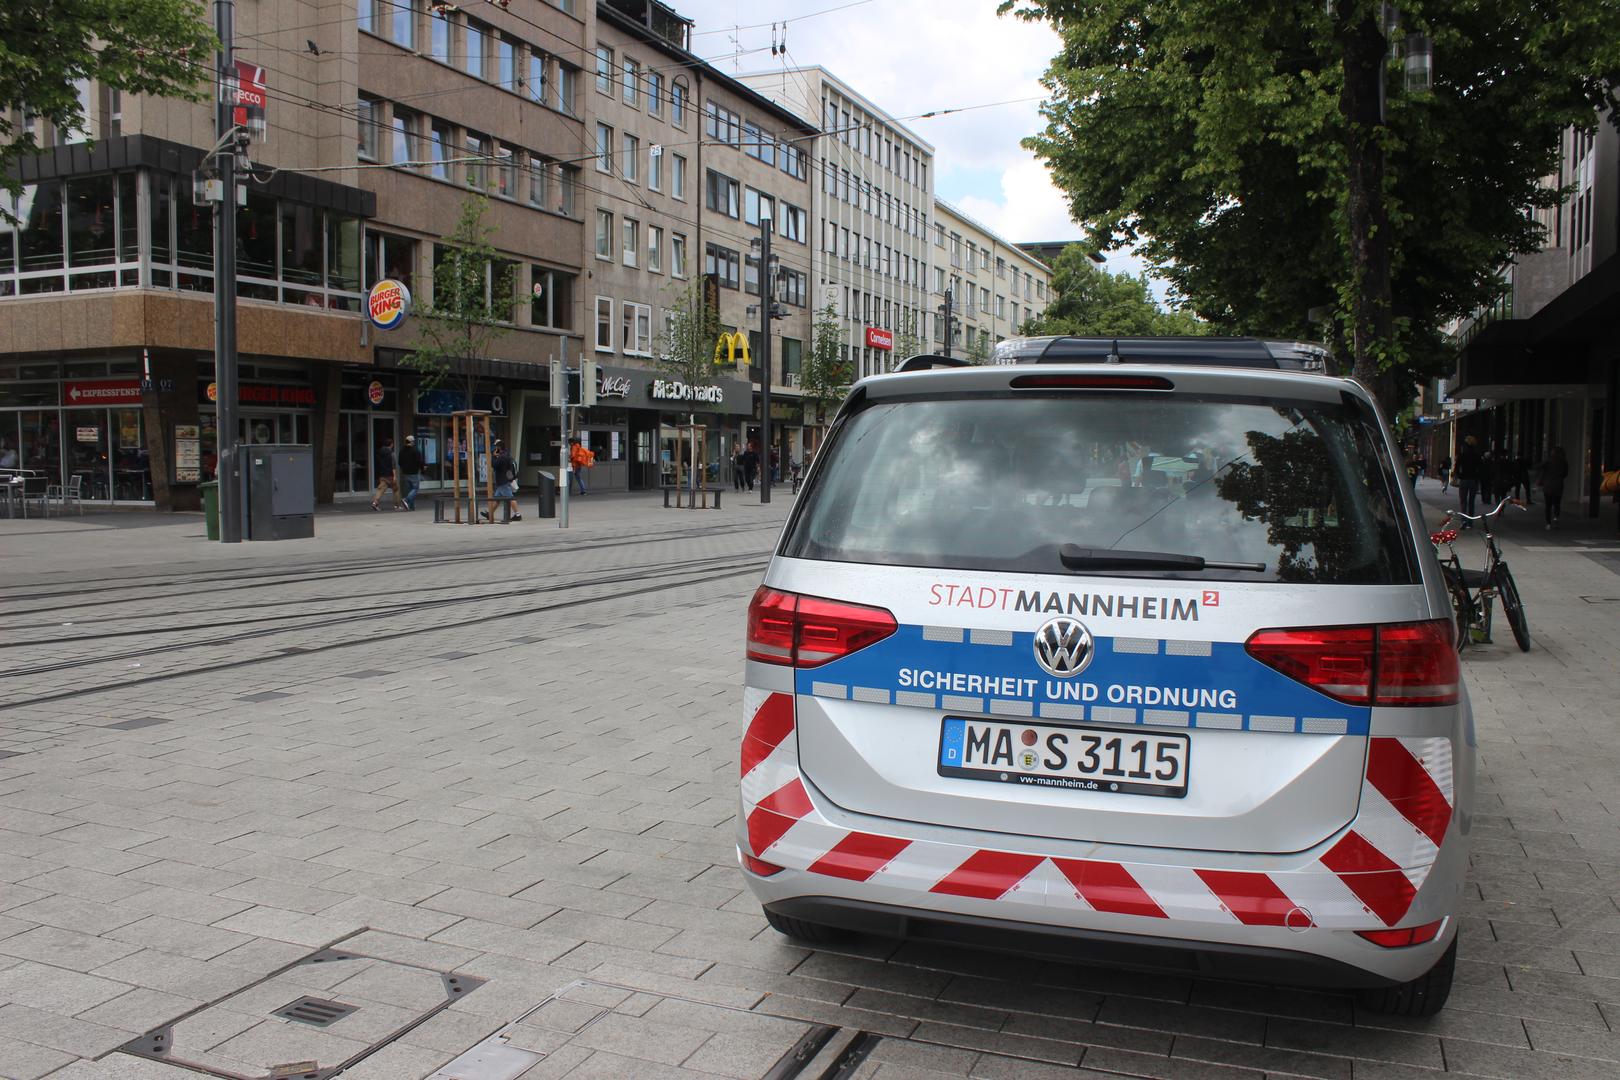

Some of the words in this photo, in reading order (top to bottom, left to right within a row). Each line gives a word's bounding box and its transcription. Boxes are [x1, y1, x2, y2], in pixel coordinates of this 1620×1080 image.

[239, 89, 261, 104] ecco
[370, 287, 401, 305] BURGER
[371, 296, 402, 318] KING
[870, 330, 892, 347] Cornelsen
[82, 387, 141, 398] EXPRESSFENST
[652, 379, 723, 402] McDonald's
[898, 668, 1038, 697] SICHERHEIT
[1046, 681, 1099, 701] UND
[1107, 684, 1236, 708] ORDNUNG
[948, 748, 957, 759] D
[965, 725, 1014, 766] MA
[1077, 735, 1181, 781] 3115
[1019, 776, 1098, 790] vw-mannheim.de
